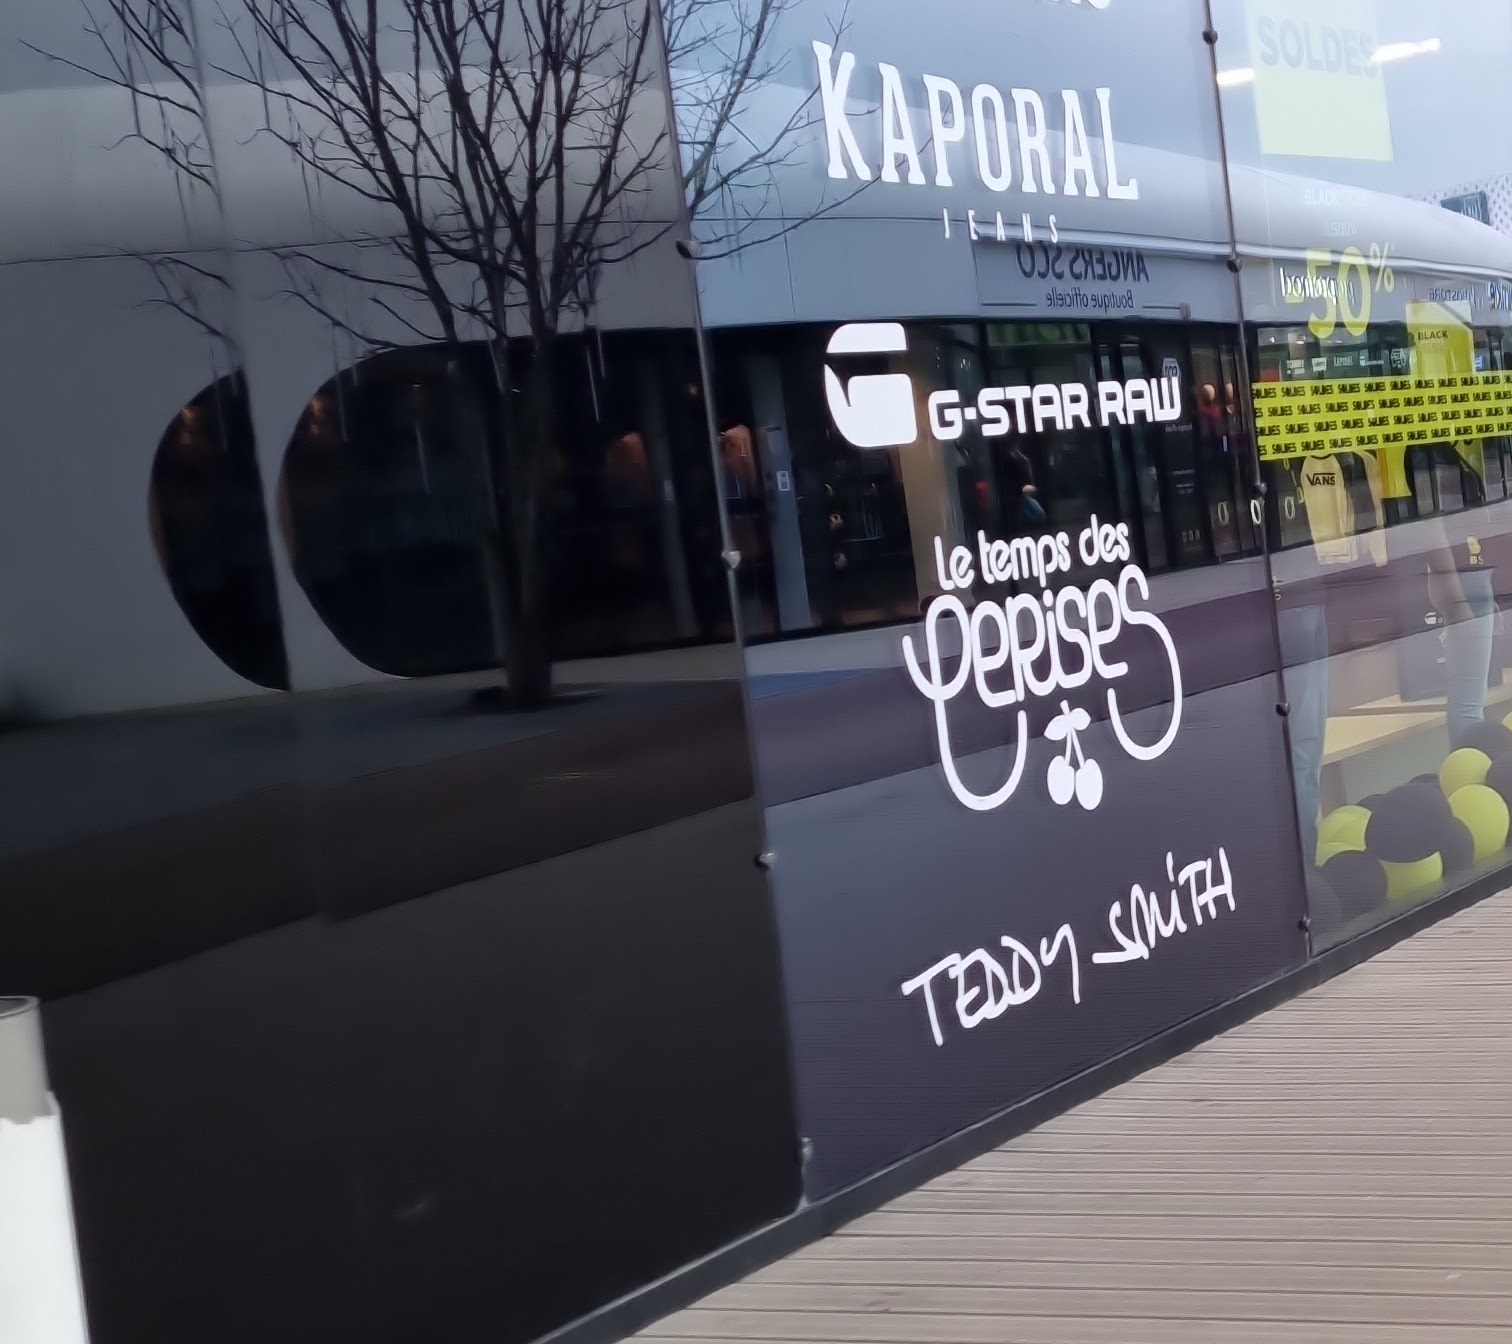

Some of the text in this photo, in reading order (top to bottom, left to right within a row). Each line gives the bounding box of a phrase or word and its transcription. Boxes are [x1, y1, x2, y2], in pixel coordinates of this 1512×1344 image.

[812, 40, 1139, 200] KAPORAL
[943, 208, 1059, 244] JEANS
[1417, 329, 1449, 340] BLACK
[928, 376, 1182, 441] G-STAR RAW
[1306, 473, 1336, 486] VANS
[978, 529, 1071, 587] temps
[1079, 513, 1130, 567] des
[901, 923, 1080, 1046] TEDDY
